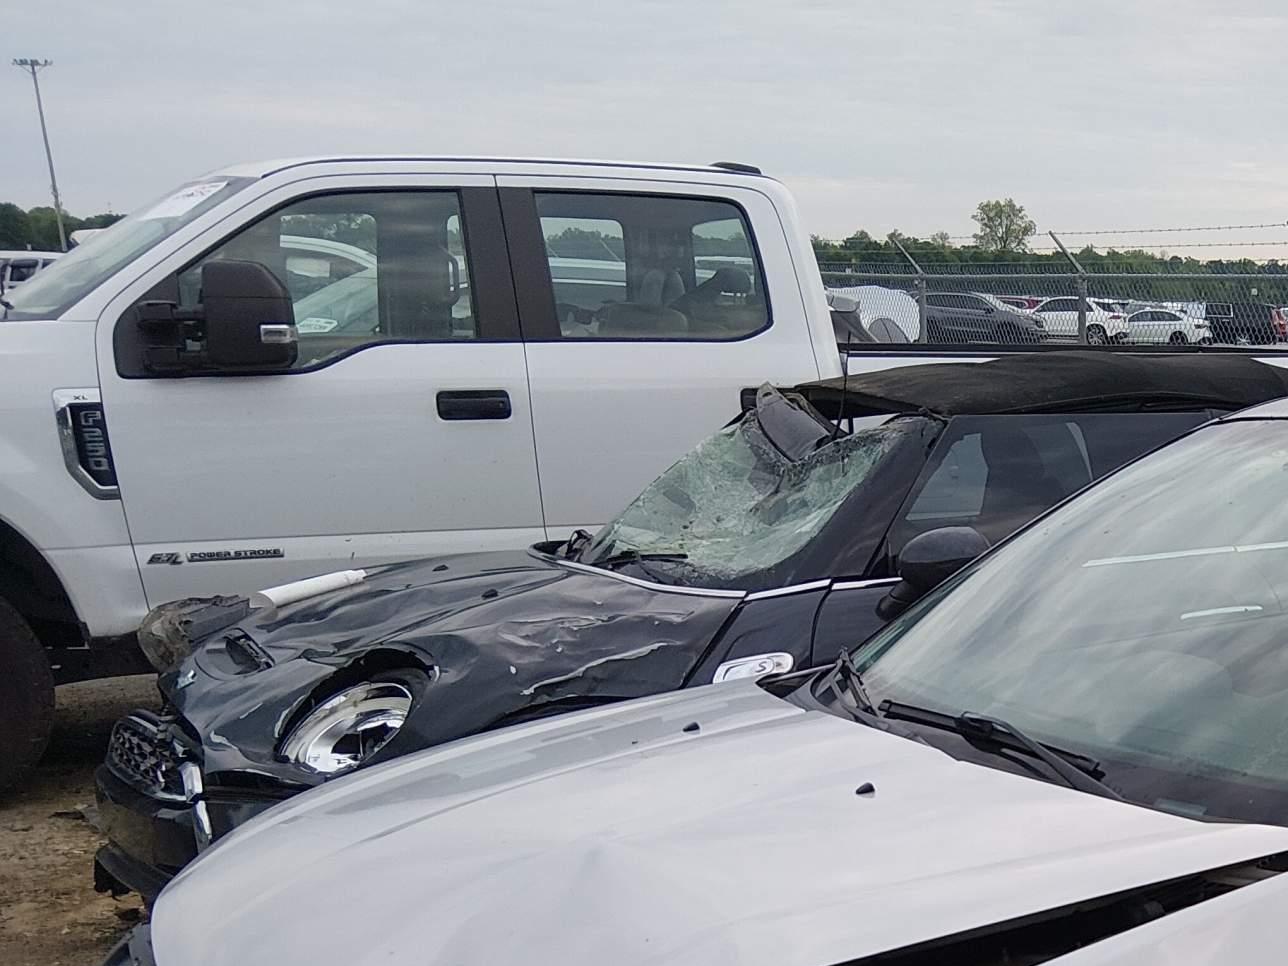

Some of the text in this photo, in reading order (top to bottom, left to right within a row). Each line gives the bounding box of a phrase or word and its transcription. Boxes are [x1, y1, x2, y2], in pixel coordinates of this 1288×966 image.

[80, 410, 110, 470] F250
[190, 551, 231, 560] POWER
[233, 548, 281, 558] STROKE
